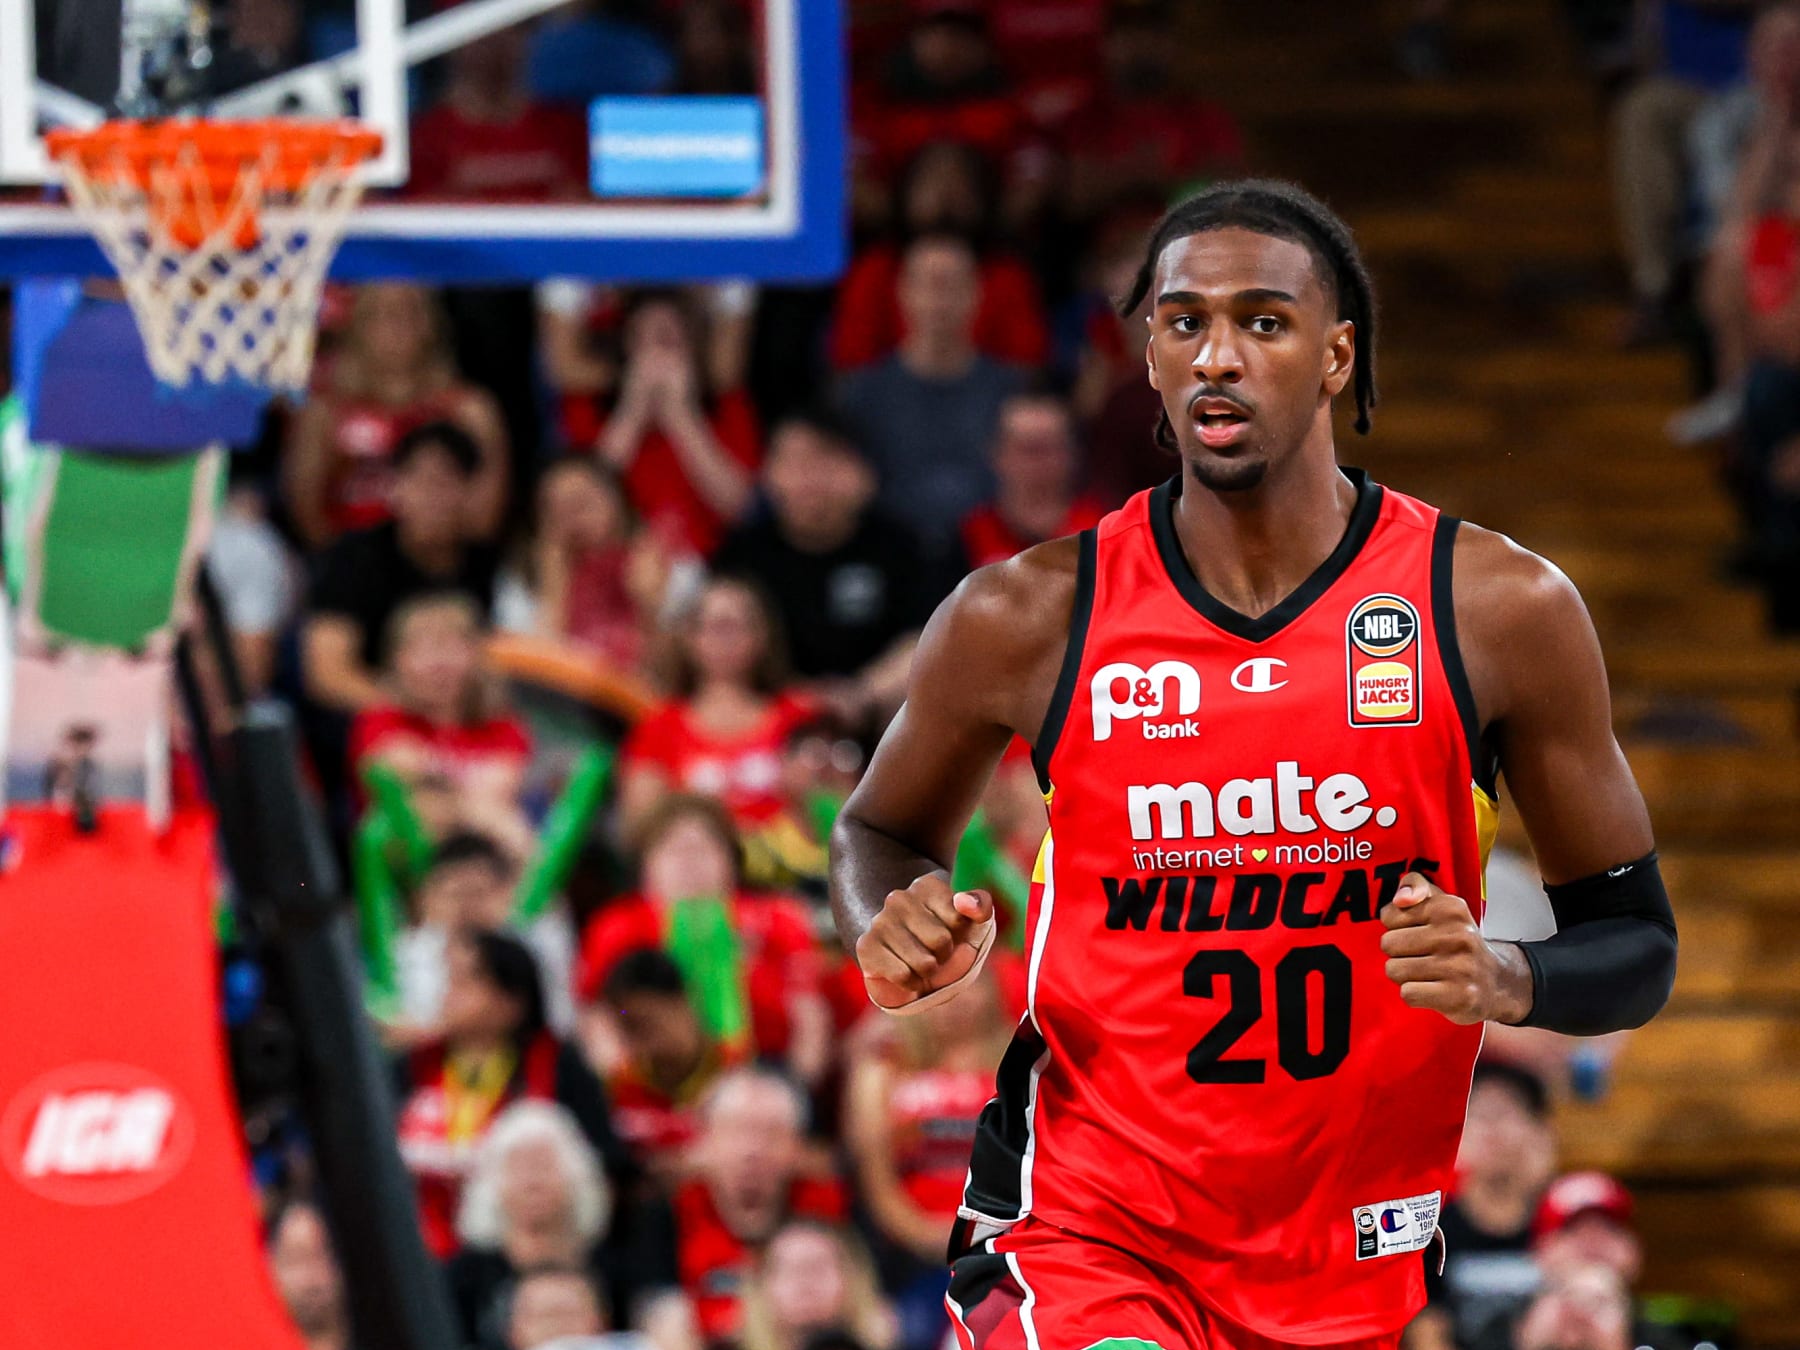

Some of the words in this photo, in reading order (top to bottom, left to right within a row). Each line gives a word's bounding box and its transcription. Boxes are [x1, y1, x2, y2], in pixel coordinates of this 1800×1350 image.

[1363, 614, 1403, 640] NBL
[1359, 677, 1410, 689] HUNGRY
[1142, 718, 1201, 740] bank
[1127, 760, 1399, 841] mate.
[1132, 842, 1245, 871] internet
[1275, 836, 1374, 865] mobile
[1183, 943, 1353, 1084] 20
[22, 1087, 176, 1178] IGA
[1414, 1207, 1438, 1223] SINCE
